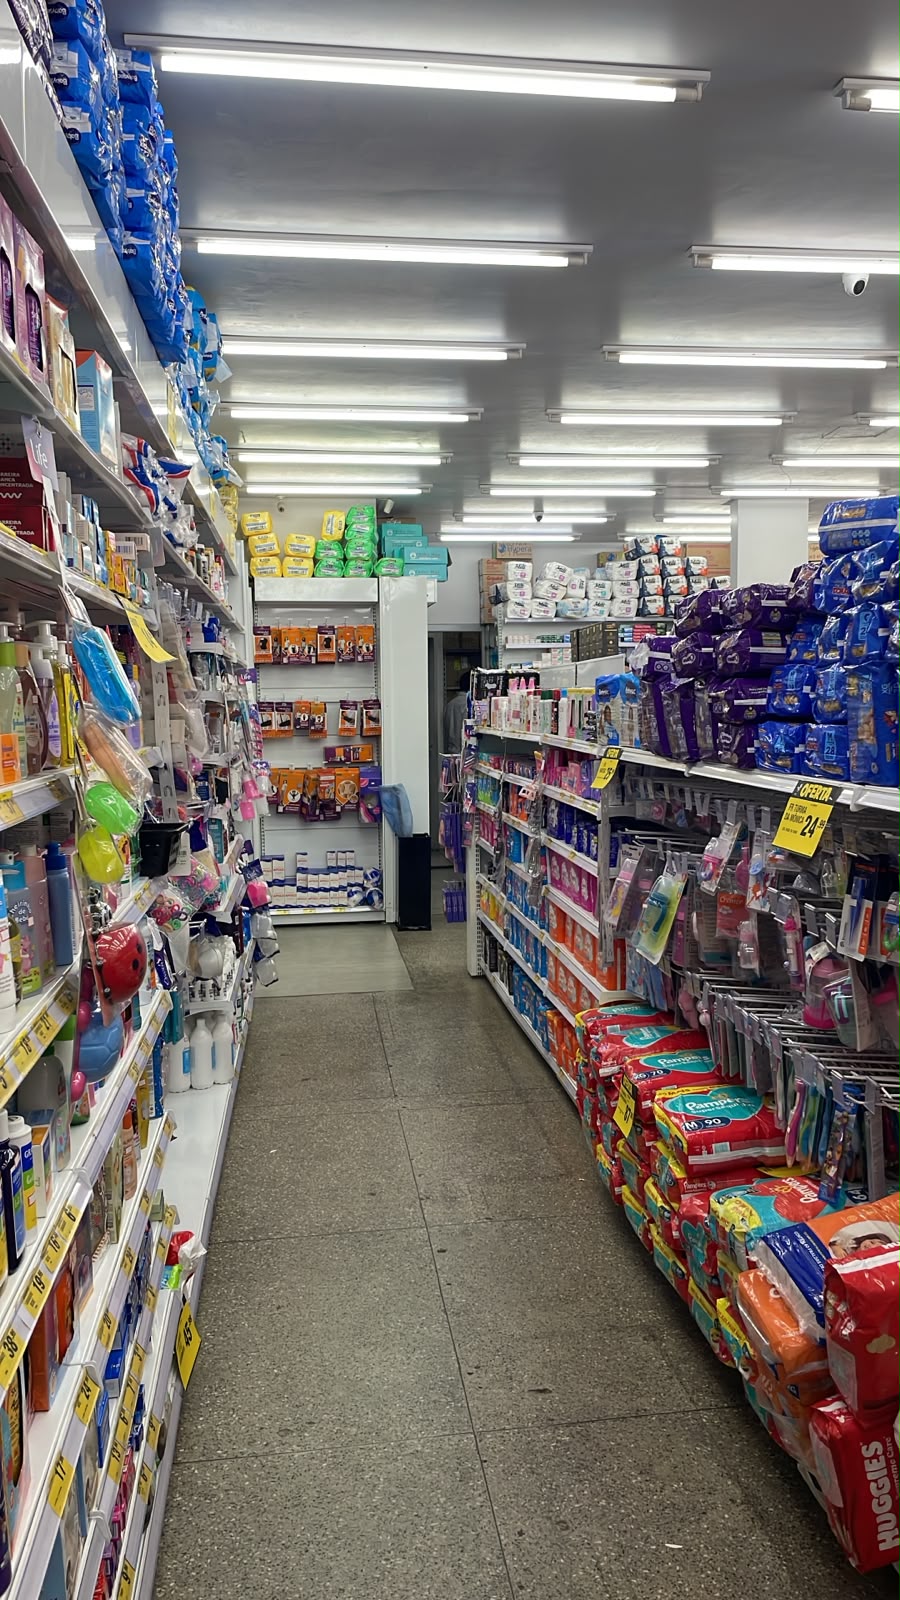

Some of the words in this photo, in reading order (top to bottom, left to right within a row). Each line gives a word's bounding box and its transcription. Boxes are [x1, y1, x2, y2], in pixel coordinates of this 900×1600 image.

[800, 782, 833, 802] OFERTA
[704, 1117, 721, 1126] 90
[782, 1177, 818, 1203] Pampers
[3, 1336, 18, 1358] 38
[885, 1436, 894, 1459] Care
[861, 1440, 900, 1551] HUGGIES
